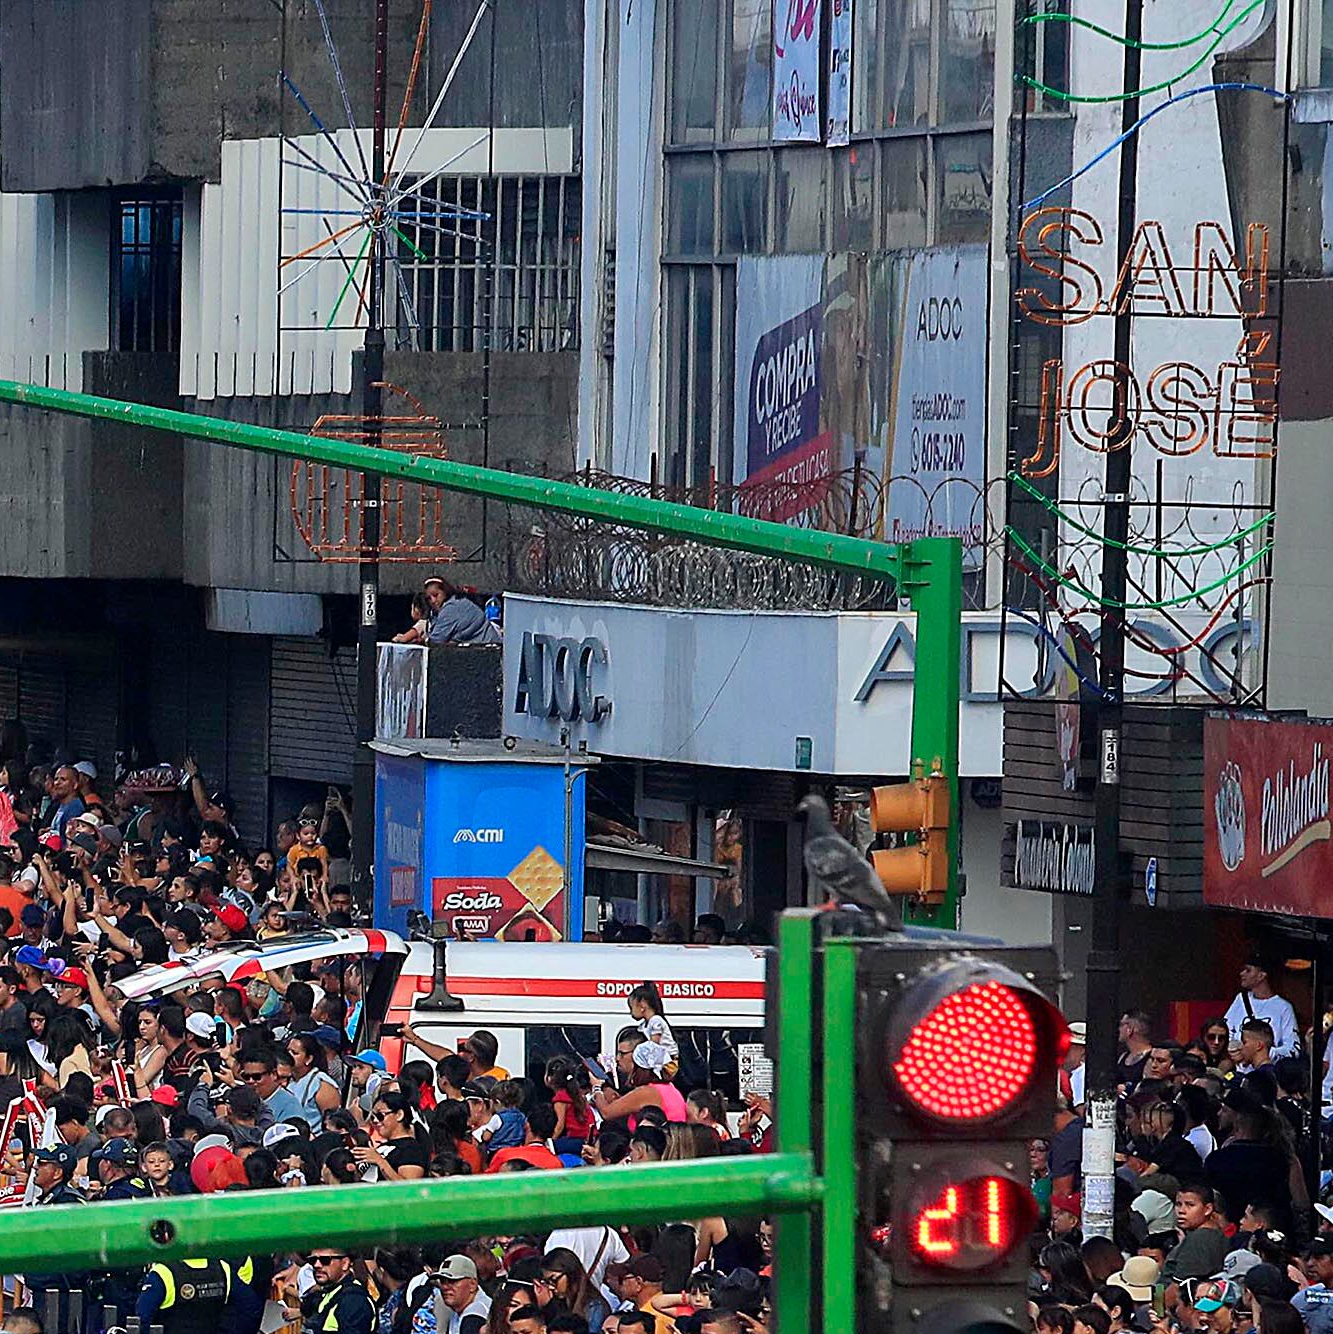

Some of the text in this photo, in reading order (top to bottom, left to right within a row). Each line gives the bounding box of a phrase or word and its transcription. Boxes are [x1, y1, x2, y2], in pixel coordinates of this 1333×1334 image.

[1014, 207, 1270, 326] SAN
[917, 296, 964, 342] ADOC
[755, 328, 817, 425] COMPRA
[1021, 330, 1282, 478] JOSÉ
[514, 631, 609, 723] ADOC
[443, 890, 503, 912] Soda
[663, 983, 715, 996] BASICO
